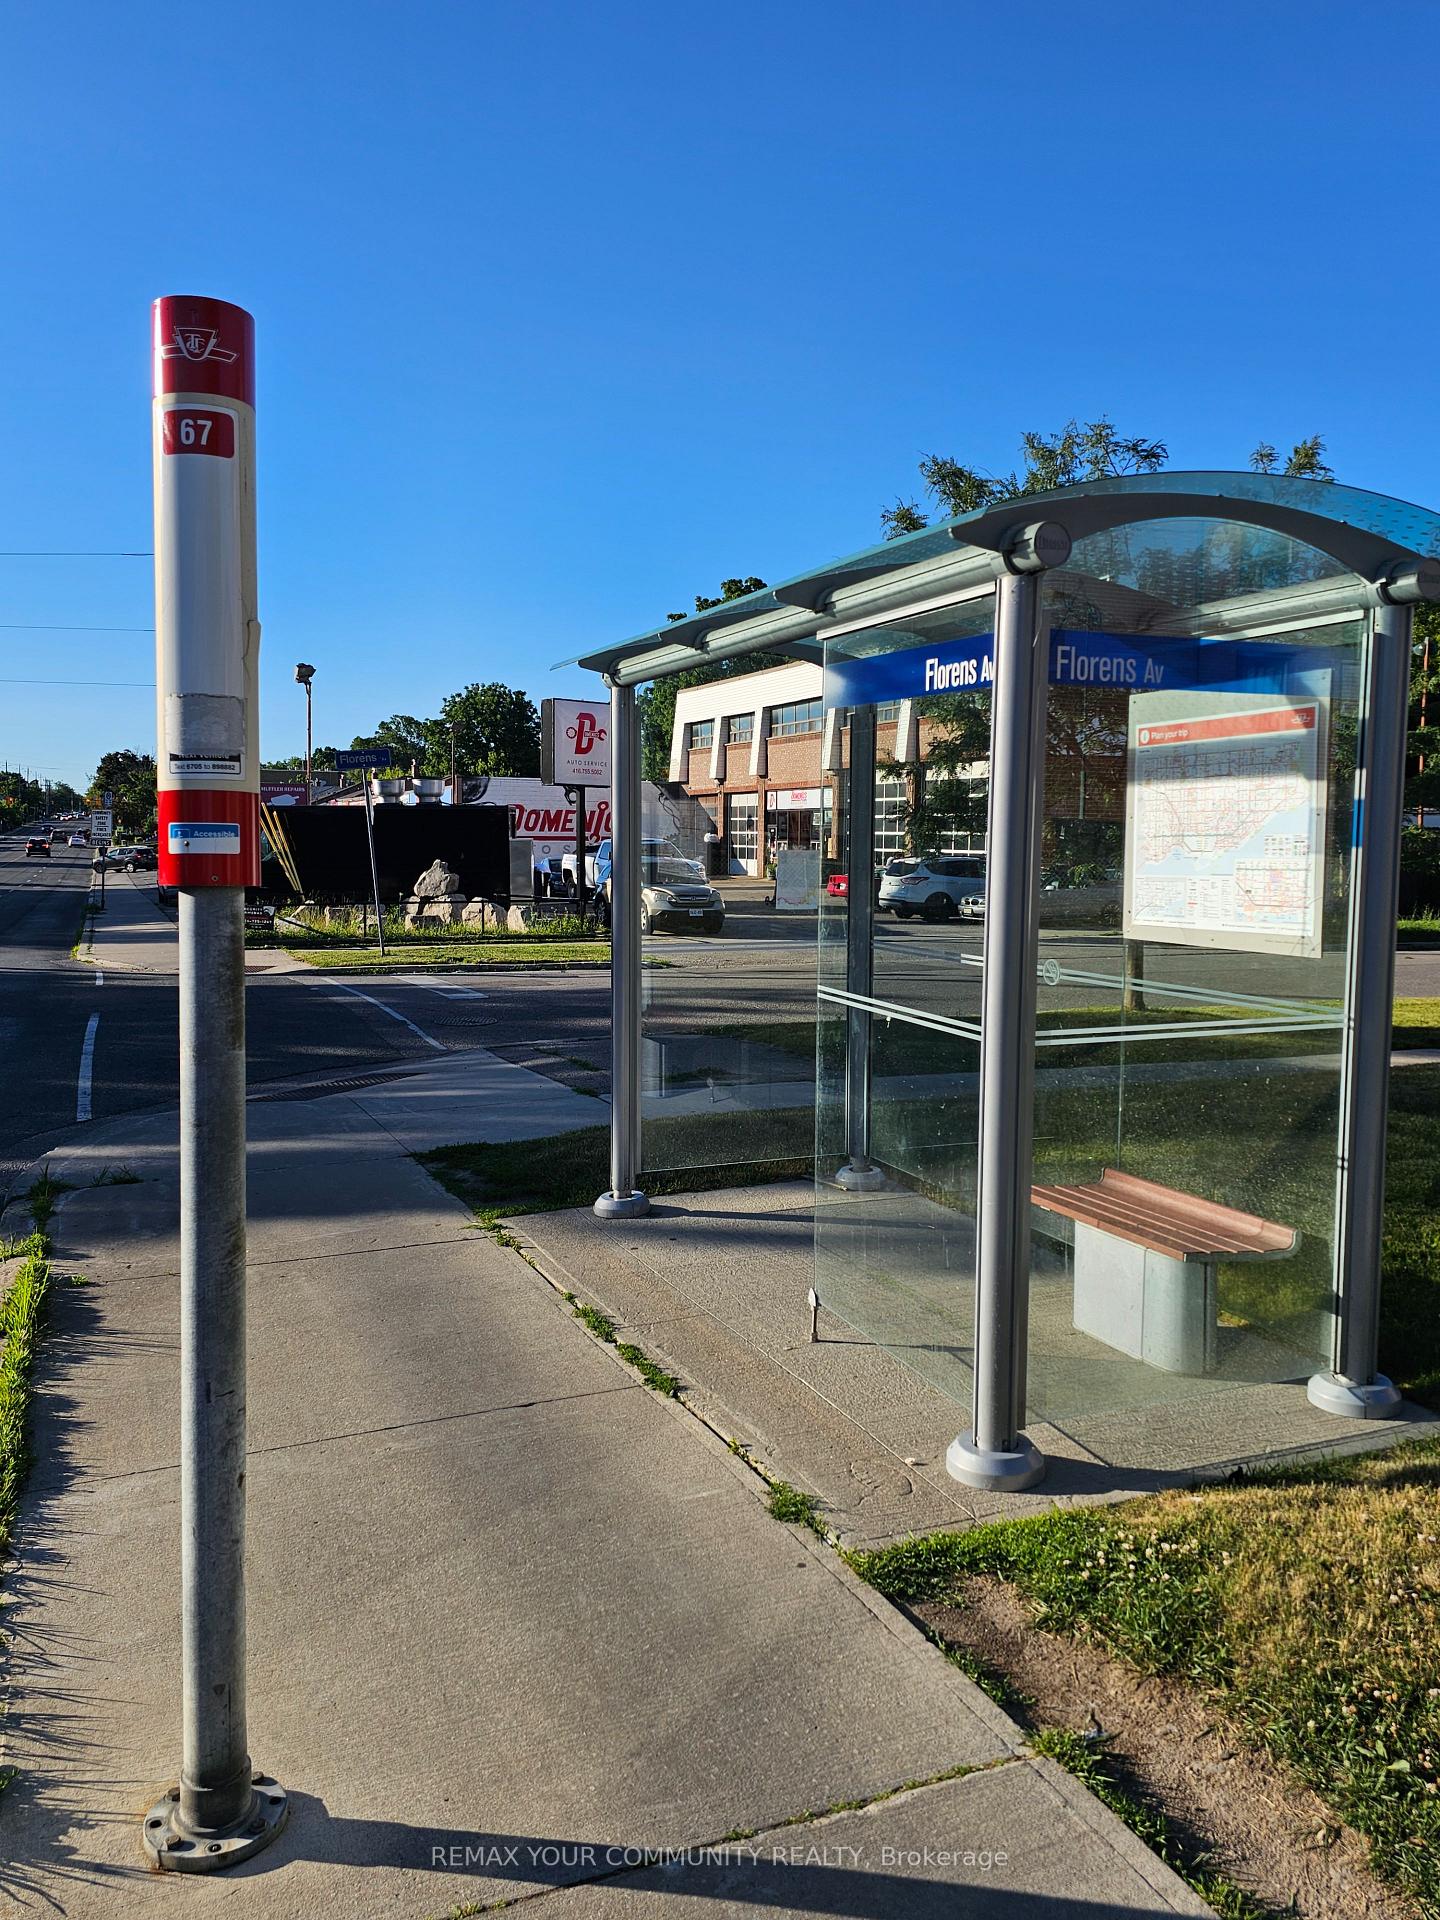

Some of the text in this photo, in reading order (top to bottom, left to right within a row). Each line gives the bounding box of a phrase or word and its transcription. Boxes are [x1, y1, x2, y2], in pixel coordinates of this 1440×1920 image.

[180, 418, 213, 446] 67
[925, 657, 977, 691] Florens
[1056, 645, 1164, 684] Florens Av
[1151, 728, 1189, 740] Plan your trip
[339, 754, 377, 765] Florens
[194, 830, 235, 838] Accessible
